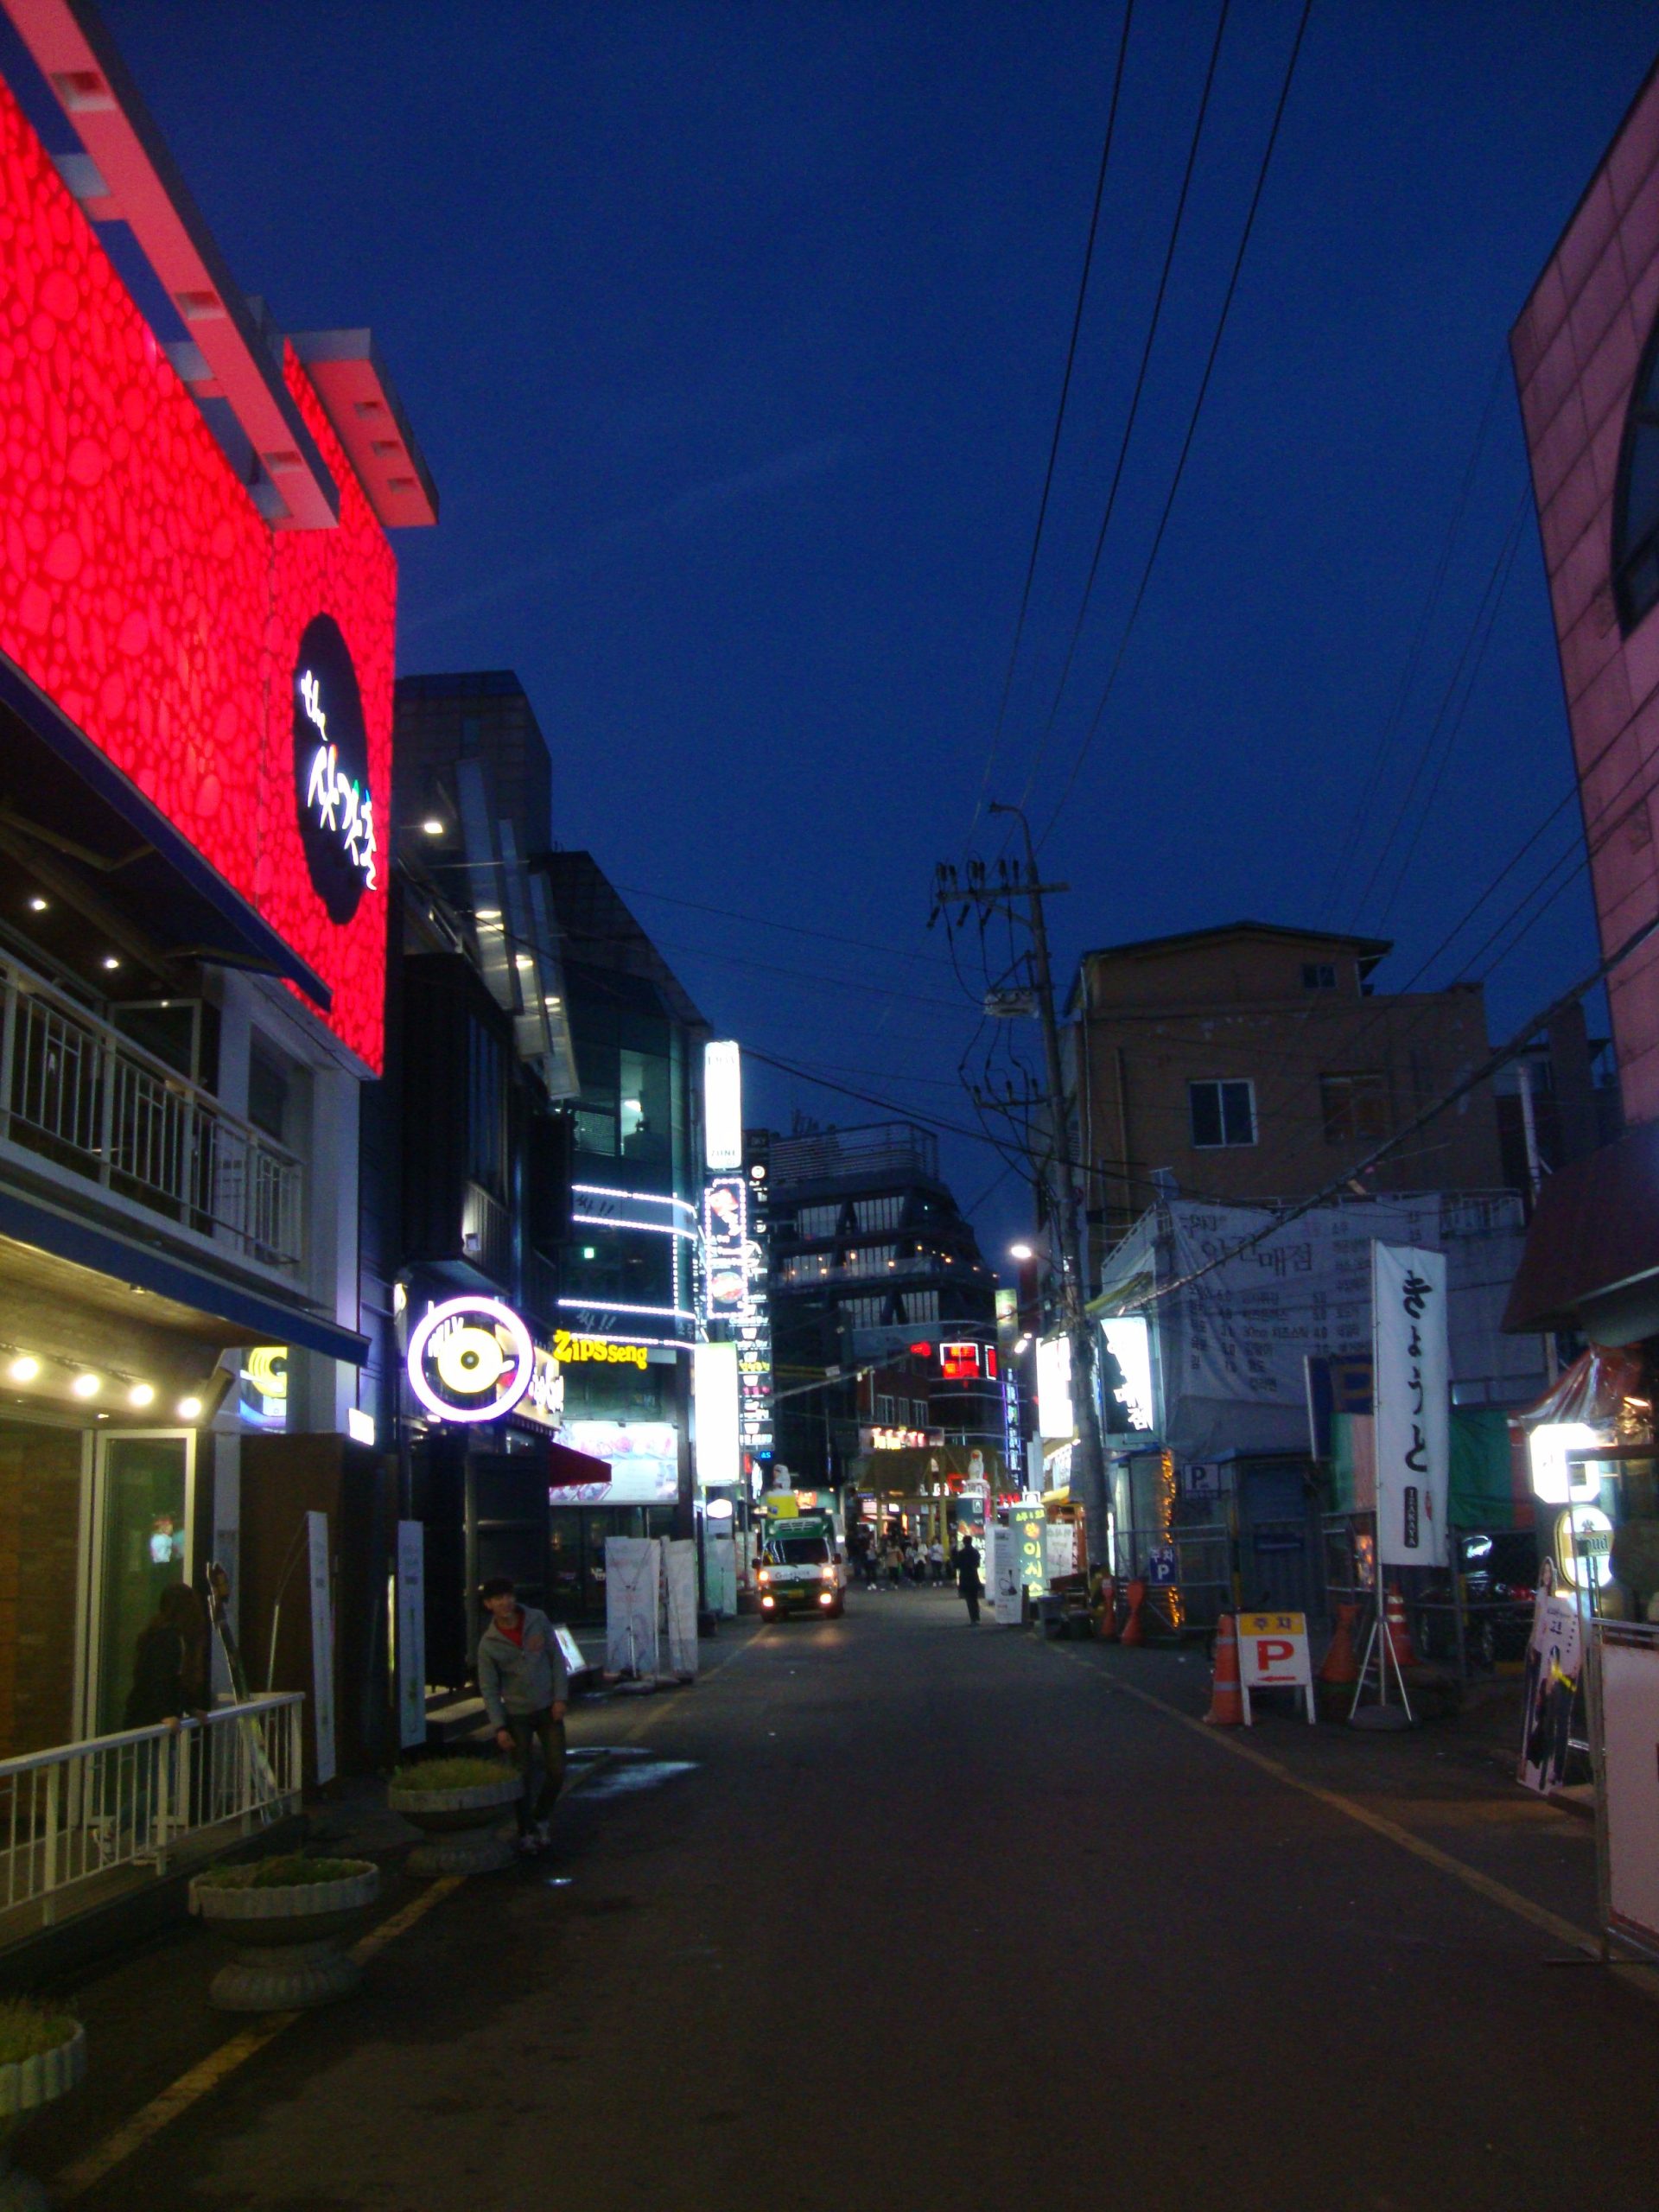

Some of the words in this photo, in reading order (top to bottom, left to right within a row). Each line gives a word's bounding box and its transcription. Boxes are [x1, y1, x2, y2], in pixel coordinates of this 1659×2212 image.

[1191, 1465, 1206, 1489] P
[1157, 1563, 1170, 1580] P
[1256, 1640, 1294, 1671] P
